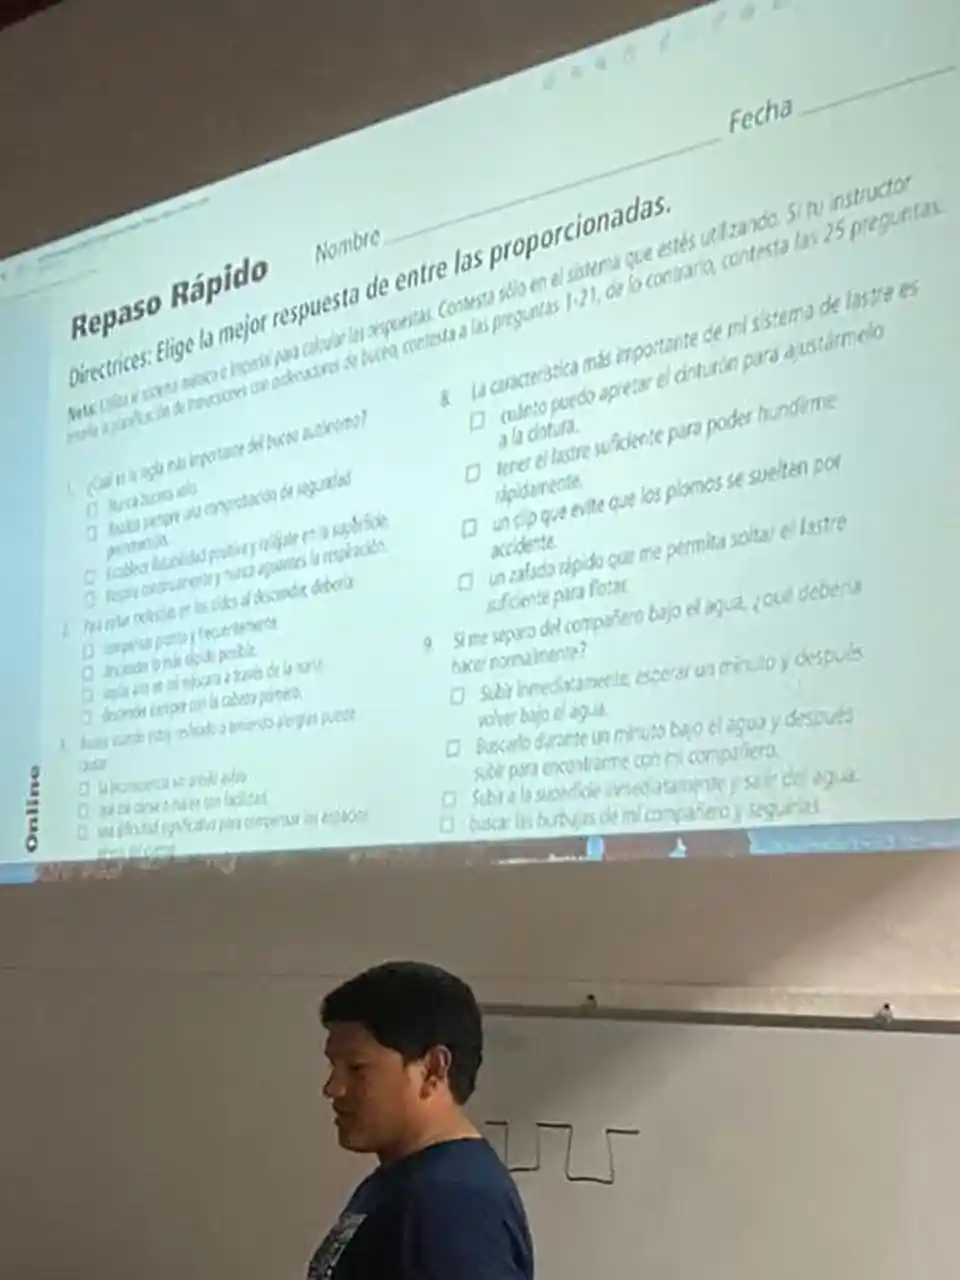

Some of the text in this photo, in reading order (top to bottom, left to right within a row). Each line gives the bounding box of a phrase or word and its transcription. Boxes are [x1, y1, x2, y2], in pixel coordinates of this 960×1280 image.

[315, 98, 793, 263] Nombre Fecha
[823, 218, 846, 244] 25
[68, 350, 152, 388] Directrices:
[156, 336, 195, 363] Elige
[199, 327, 214, 349] la
[218, 313, 268, 344] mejor
[272, 286, 360, 327] respuesta
[365, 274, 390, 300] de
[394, 260, 448, 291] entre
[454, 248, 484, 274] las
[489, 195, 673, 270] proporcionadas.
[71, 257, 268, 340] Repaso Rápido
[471, 382, 487, 401] La
[615, 331, 699, 365] importante
[702, 324, 723, 344] de
[751, 303, 815, 333] sistema
[819, 295, 841, 316] de
[898, 281, 919, 299] es
[656, 366, 671, 388] el
[742, 347, 780, 372] para
[499, 433, 508, 448] a
[511, 426, 524, 446] la
[534, 450, 548, 470] el
[667, 420, 703, 446] para
[706, 407, 752, 439] poder
[492, 515, 510, 532] un
[540, 504, 568, 527] que
[607, 491, 636, 512] que
[640, 485, 662, 505] los
[664, 474, 723, 505] plomos
[726, 472, 744, 489] se
[488, 571, 506, 587] un
[639, 545, 662, 561] me
[779, 523, 795, 540] el
[553, 702, 566, 721] el
[708, 716, 722, 735] el
[25, 764, 40, 852] Online
